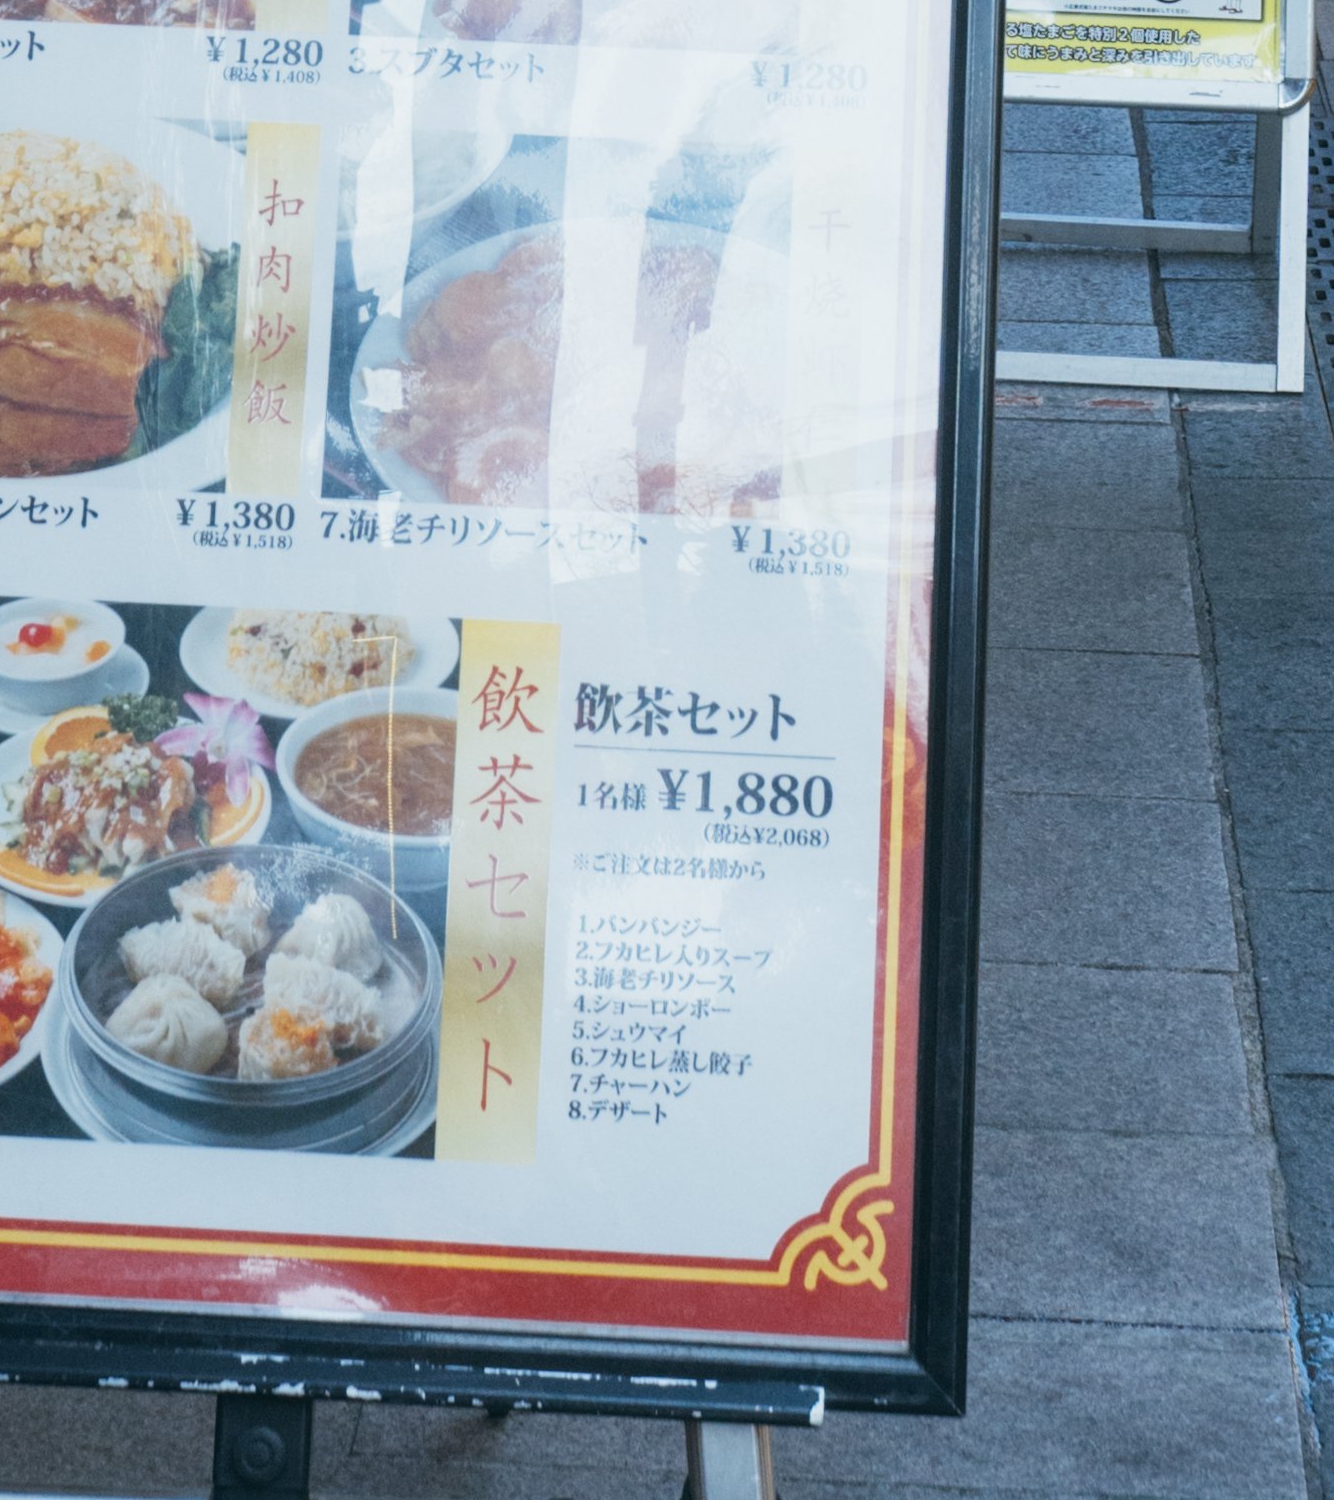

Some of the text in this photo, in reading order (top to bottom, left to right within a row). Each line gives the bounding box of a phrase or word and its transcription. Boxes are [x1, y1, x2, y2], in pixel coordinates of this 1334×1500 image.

[241, 176, 306, 429] 扣肉炒飯
[573, 681, 797, 743] 飲茶セット
[577, 782, 648, 813] 1名様
[465, 663, 545, 1113] 飲茶セット
[576, 939, 774, 969] 2.フカヒレ入りスープ
[574, 966, 737, 996] 3.海老チリソース
[571, 1020, 687, 1046] 5.シュウマイ
[570, 1045, 754, 1078] 6.フカヒレ蒸し餃子
[569, 1073, 693, 1099] 7.チャーハン
[567, 1099, 669, 1125] 8.デザート
